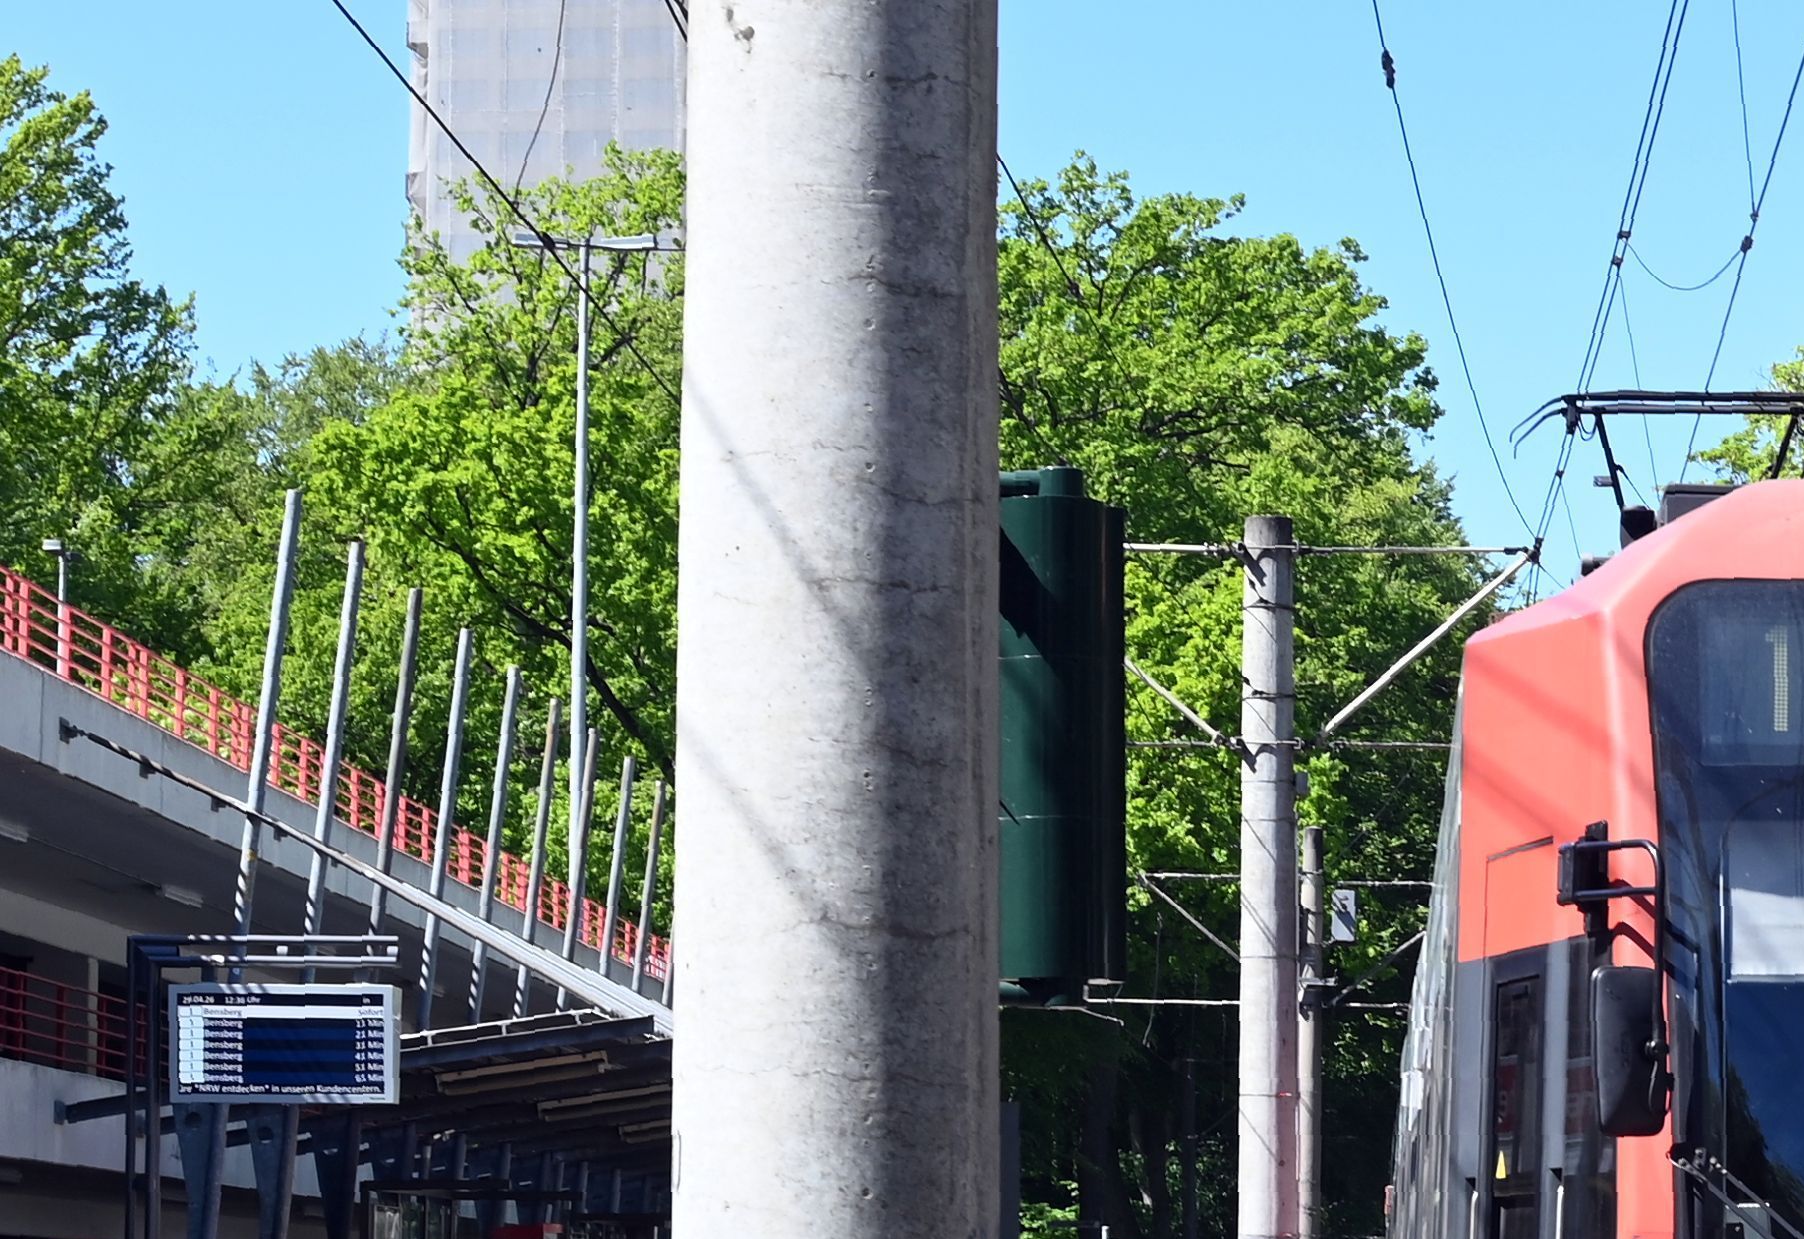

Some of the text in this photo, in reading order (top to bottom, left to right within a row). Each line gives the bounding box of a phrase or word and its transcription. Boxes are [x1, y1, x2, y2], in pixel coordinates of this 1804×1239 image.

[1765, 625, 1789, 732] 1
[246, 996, 261, 1004] Uhr
[204, 1008, 242, 1016] Bensberg
[204, 1019, 243, 1029] Bensberg
[204, 1030, 243, 1039] Bensberg
[204, 1041, 243, 1050] Bensberg
[204, 1052, 243, 1061] Bensberg
[367, 1052, 384, 1060] Min
[204, 1063, 243, 1072] Bensberg
[367, 1063, 384, 1071] Min
[204, 1074, 243, 1083] Bensberg
[367, 1074, 384, 1082] Min
